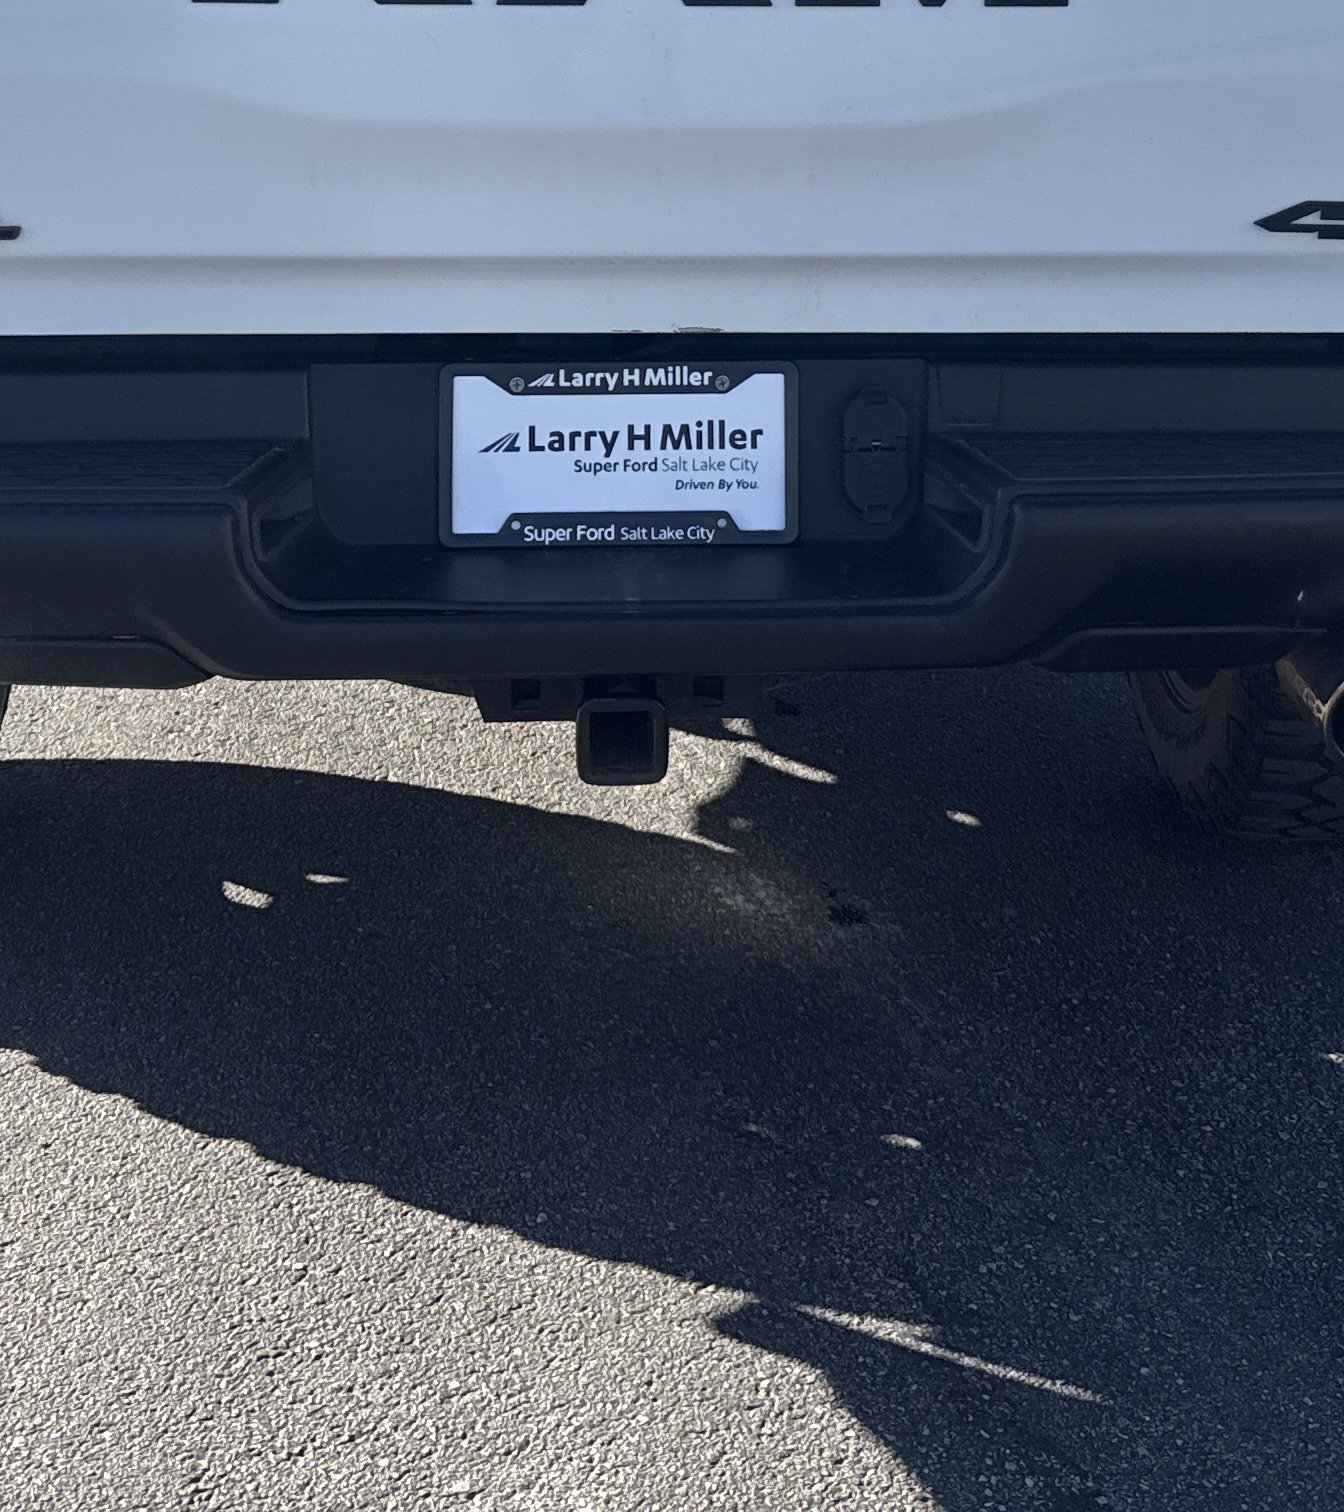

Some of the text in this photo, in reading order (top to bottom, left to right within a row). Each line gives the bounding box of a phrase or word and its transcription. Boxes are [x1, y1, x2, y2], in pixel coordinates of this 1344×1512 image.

[558, 366, 713, 391] Larry H Miller
[528, 420, 764, 458] Larry H Miller
[573, 456, 759, 476] Super Ford Salt Lake City
[675, 479, 715, 491] Driven
[718, 479, 734, 492] By
[523, 524, 716, 545] Super Ford Salt Lake City
